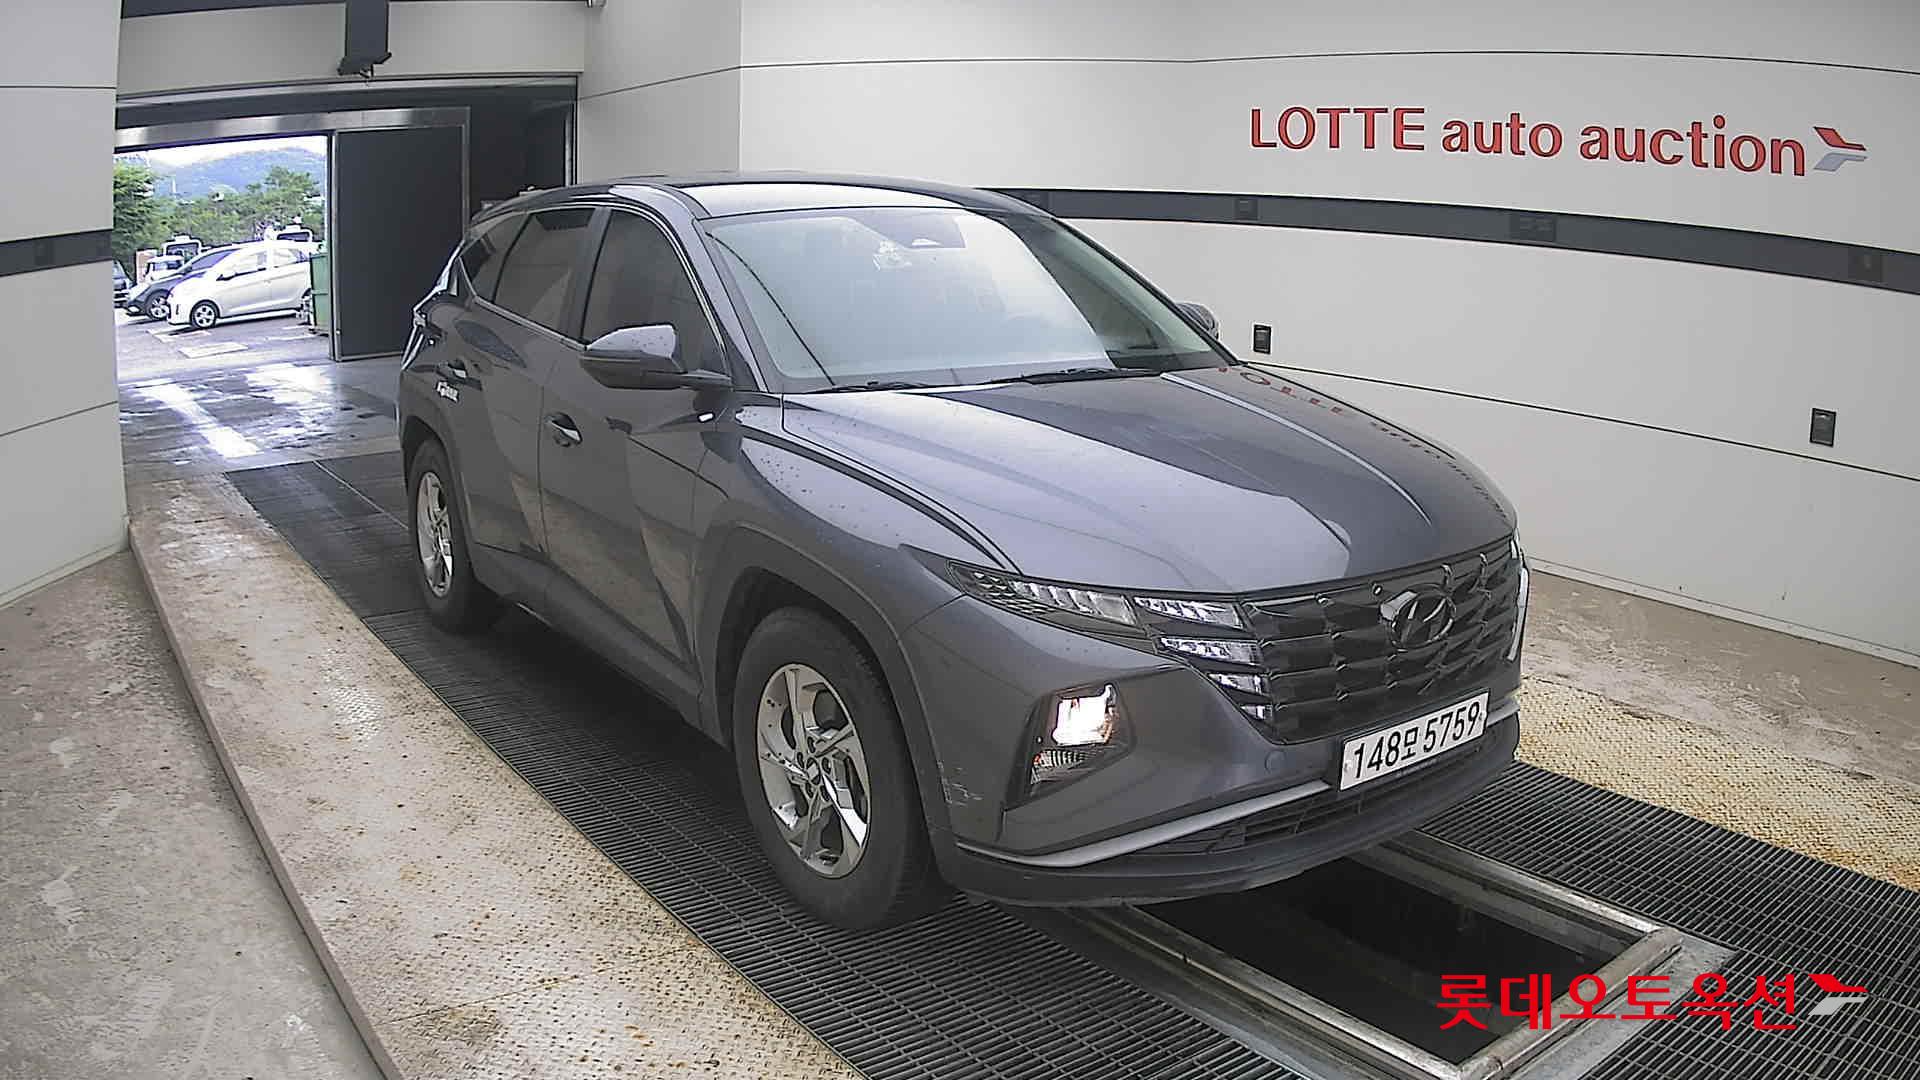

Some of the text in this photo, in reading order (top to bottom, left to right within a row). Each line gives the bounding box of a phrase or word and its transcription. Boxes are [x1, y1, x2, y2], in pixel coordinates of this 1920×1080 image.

[1250, 107, 1807, 177] LOTTE auto auction
